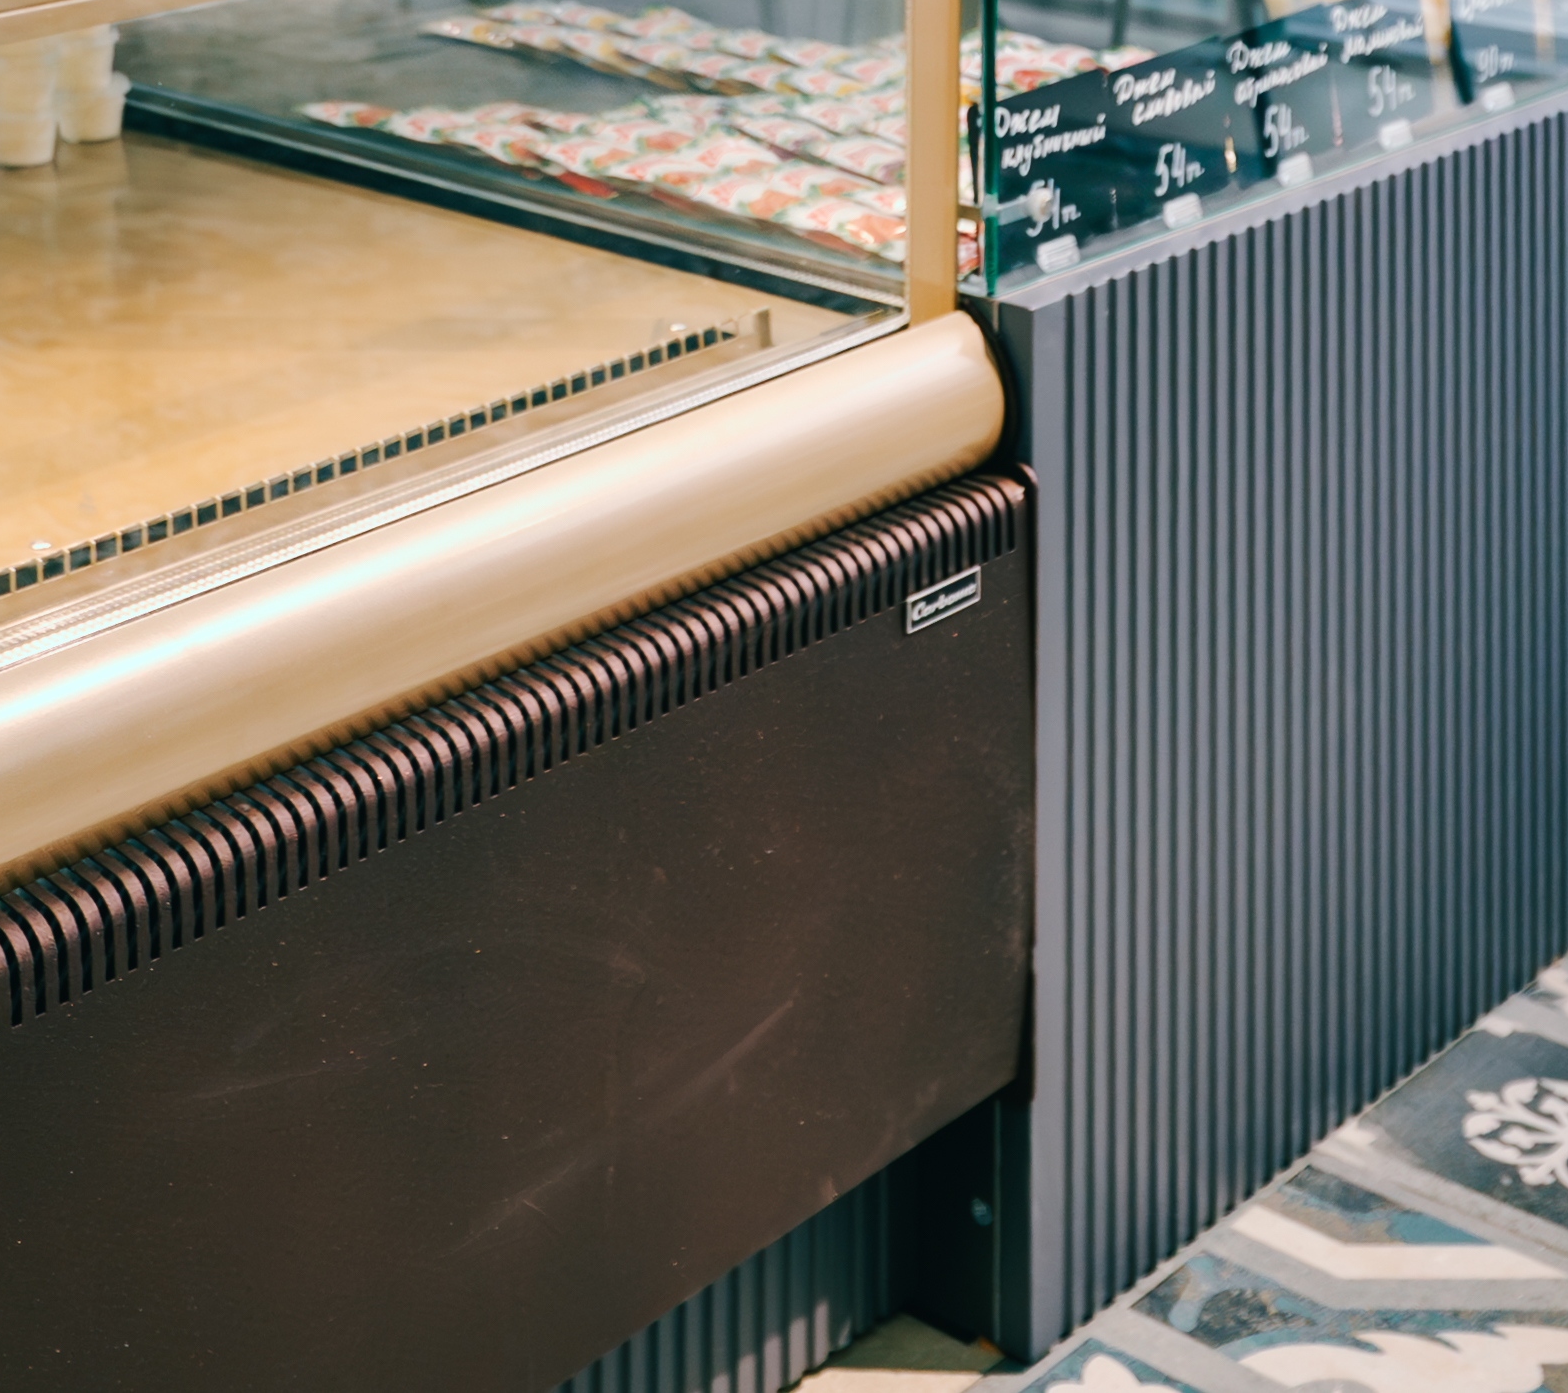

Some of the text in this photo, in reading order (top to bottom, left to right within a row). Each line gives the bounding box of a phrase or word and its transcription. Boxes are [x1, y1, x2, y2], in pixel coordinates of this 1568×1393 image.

[1330, 3, 1389, 35] Джем
[1225, 39, 1292, 75] Джем
[1113, 67, 1177, 107] Джем
[994, 103, 1061, 139] Джем
[1000, 112, 1107, 178] клубничный
